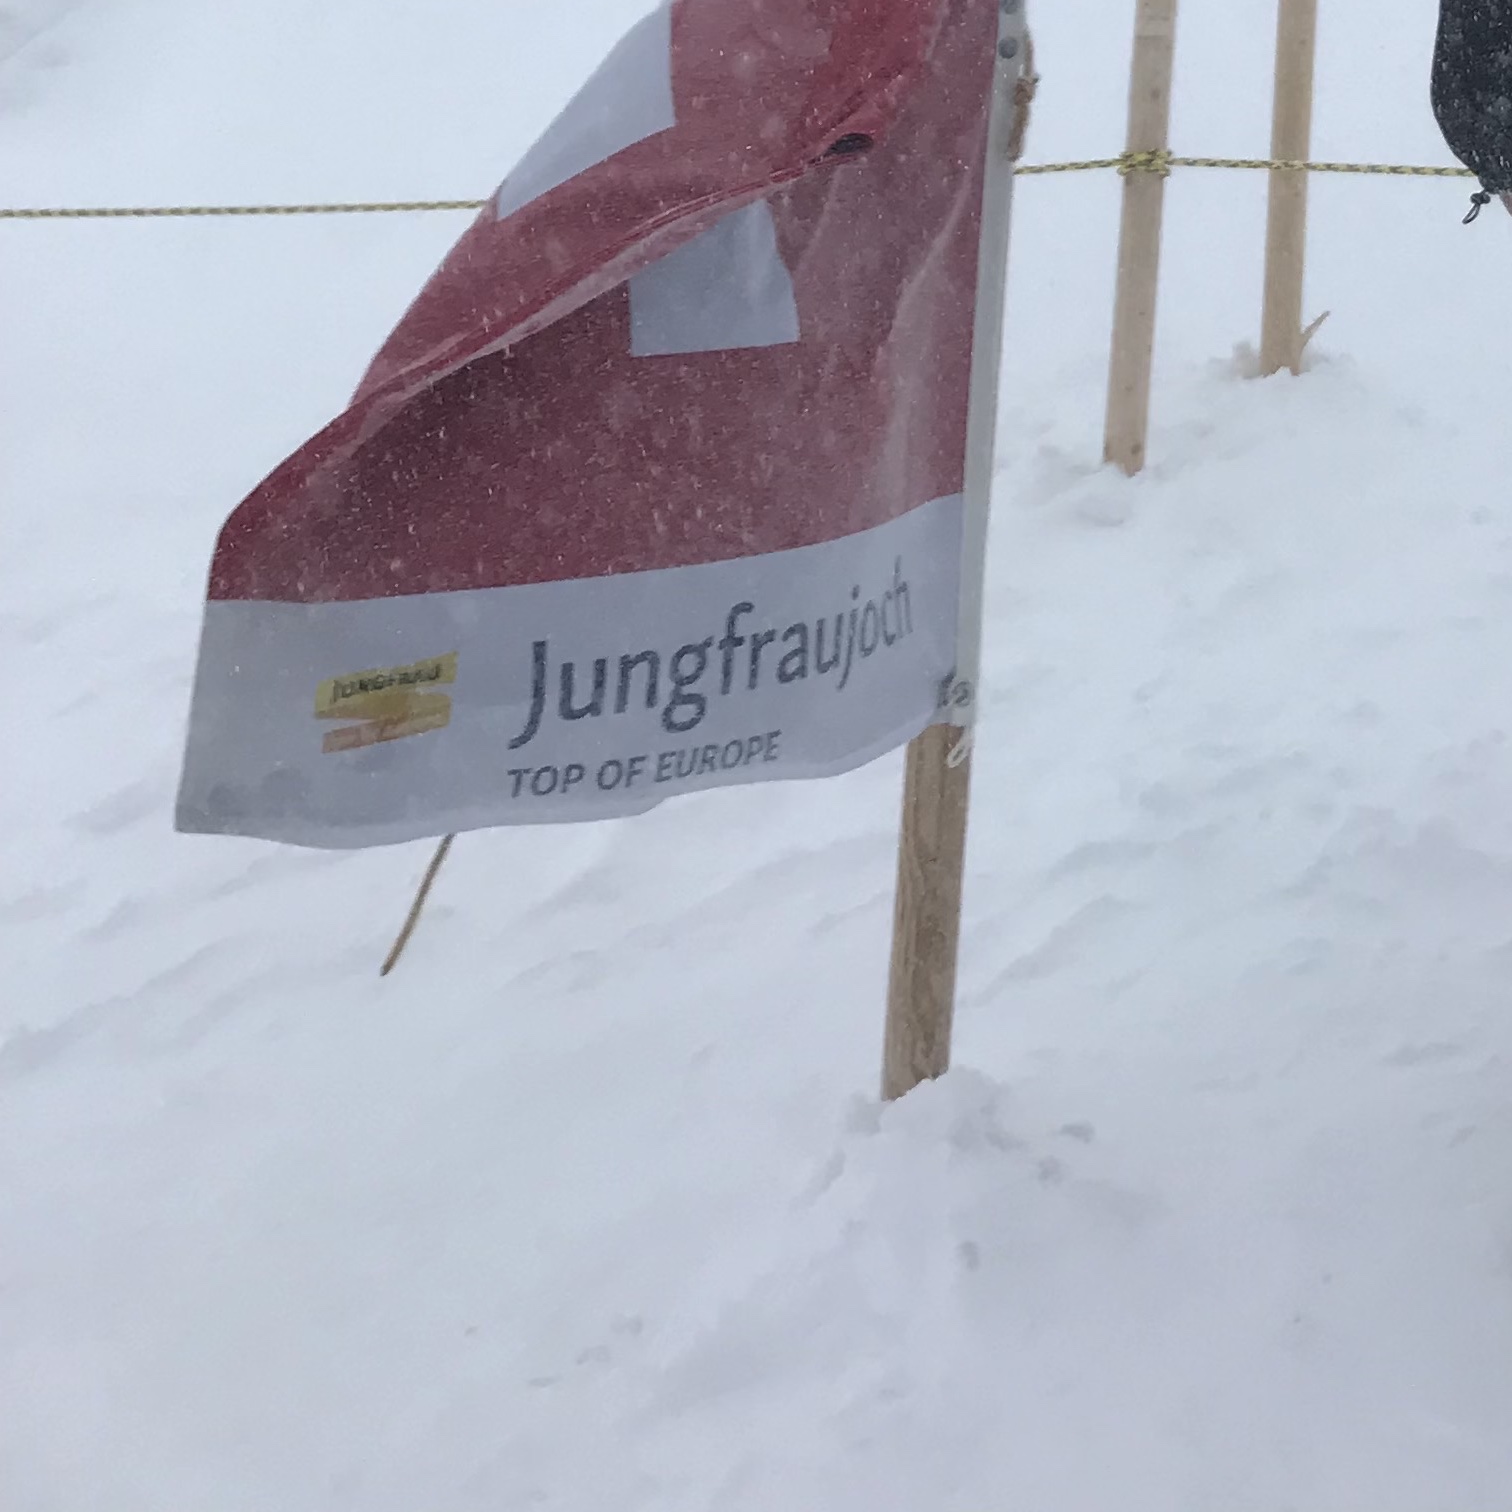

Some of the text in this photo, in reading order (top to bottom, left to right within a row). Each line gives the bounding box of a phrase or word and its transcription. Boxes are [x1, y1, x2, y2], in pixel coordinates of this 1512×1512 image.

[506, 555, 913, 750] Jungfraujoch
[507, 728, 783, 798] TOP OF EUROPE
